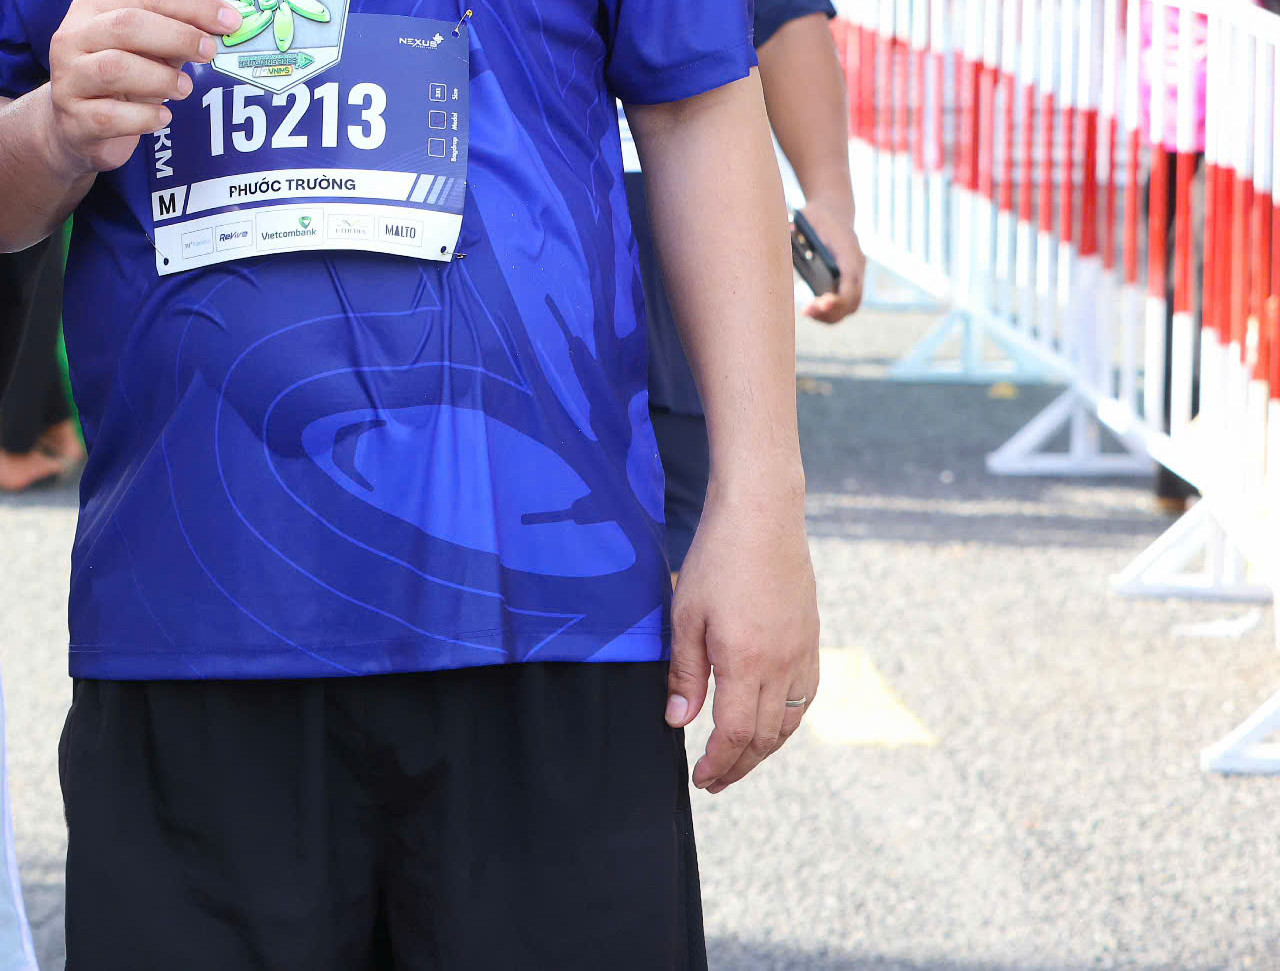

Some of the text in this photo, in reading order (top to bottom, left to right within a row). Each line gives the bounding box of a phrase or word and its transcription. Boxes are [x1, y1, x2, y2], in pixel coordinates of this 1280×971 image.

[399, 36, 438, 48] NEXUS
[202, 82, 387, 157] 15213
[154, 127, 173, 178] KM
[229, 177, 356, 198] PHƯỚC TRƯỜNG
[158, 192, 176, 216] M
[219, 230, 248, 242] ReVive
[261, 227, 317, 241] Vietcombank
[384, 223, 417, 239] MALTO
